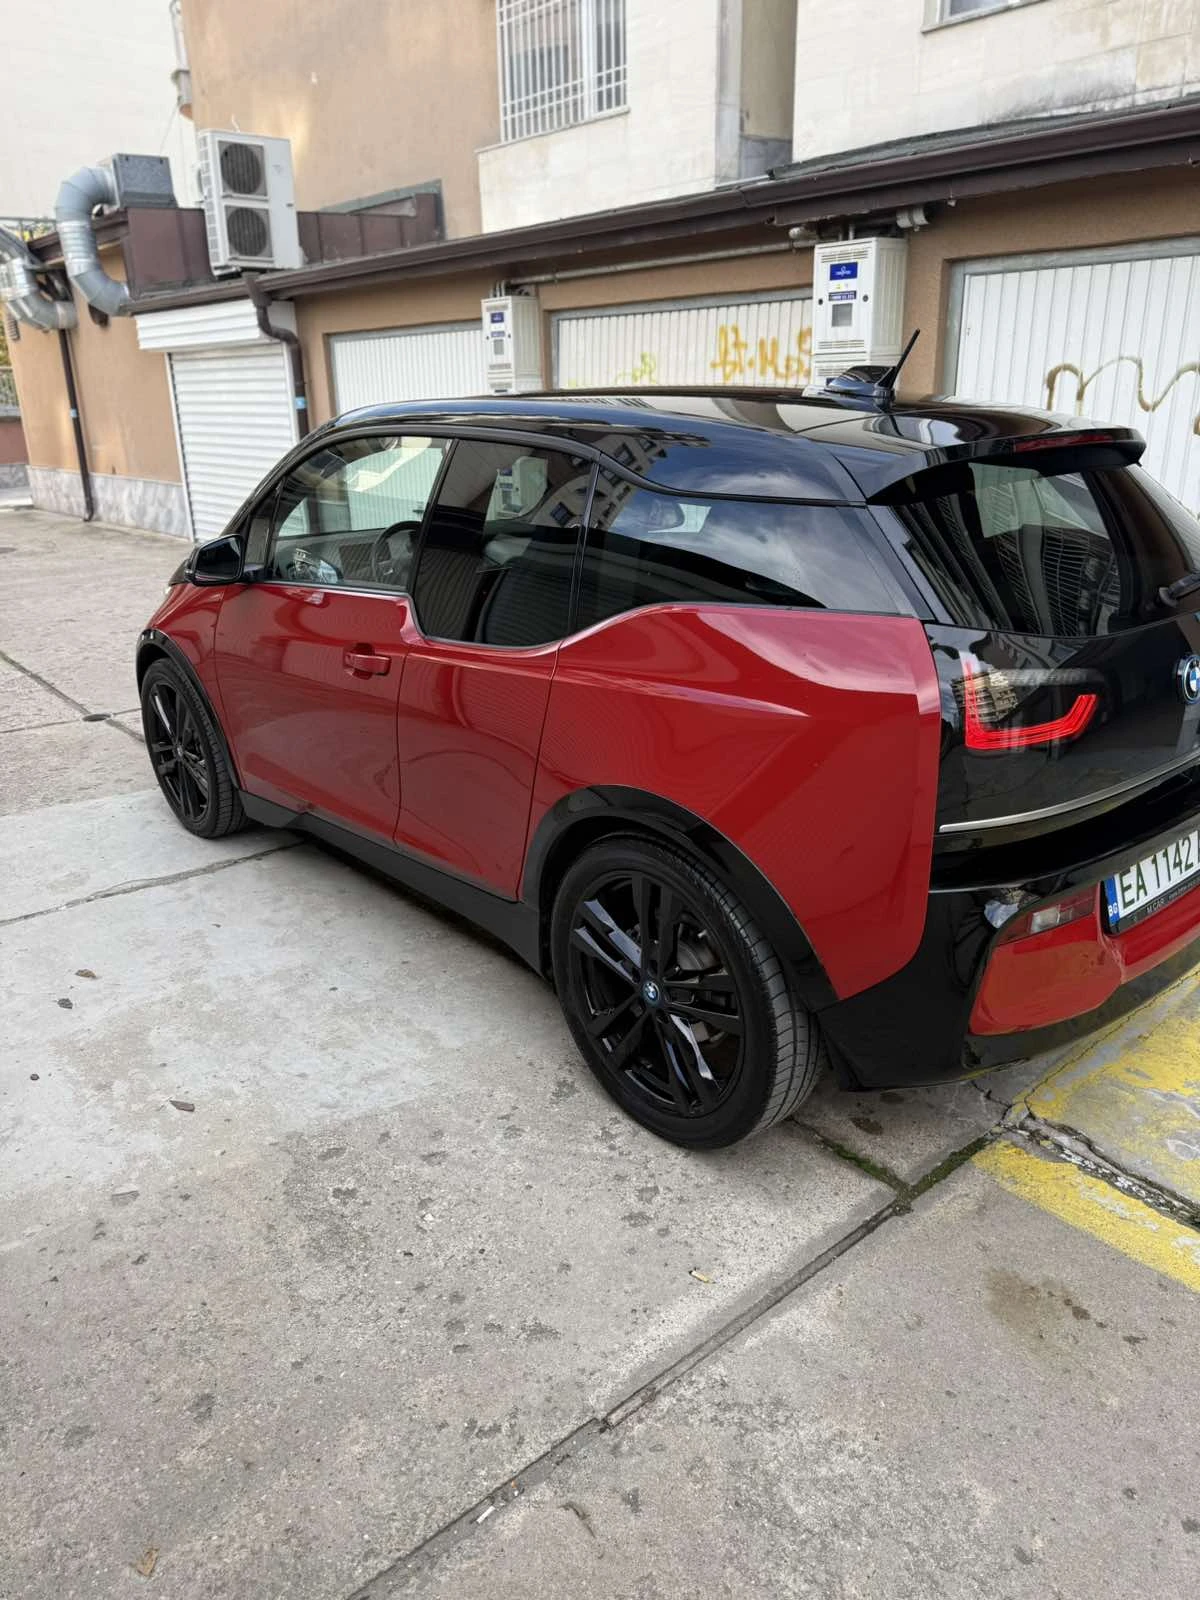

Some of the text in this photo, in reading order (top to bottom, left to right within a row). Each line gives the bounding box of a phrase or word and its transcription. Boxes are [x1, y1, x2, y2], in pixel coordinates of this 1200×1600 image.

[1120, 861, 1147, 909] EA
[1152, 836, 1194, 889] 1142
[1108, 902, 1118, 917] BG
